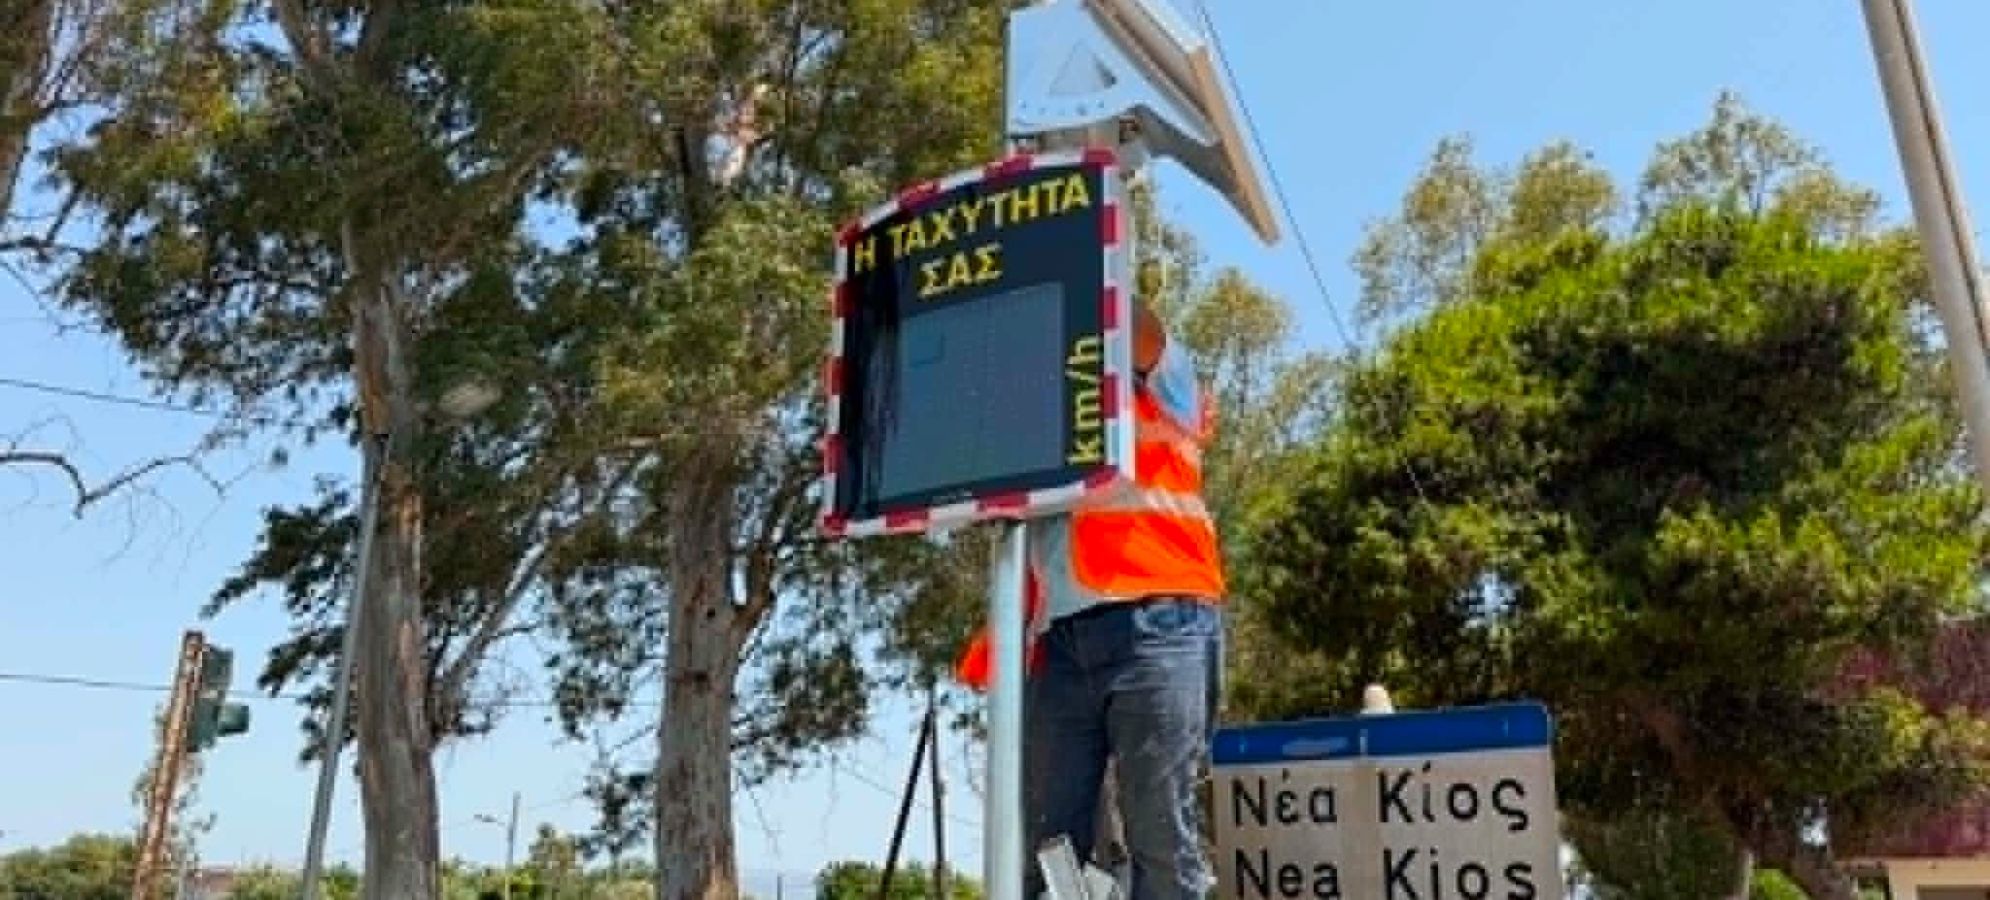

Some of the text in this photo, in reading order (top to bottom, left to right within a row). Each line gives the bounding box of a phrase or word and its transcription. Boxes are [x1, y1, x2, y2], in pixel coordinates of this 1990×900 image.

[854, 173, 1090, 273] Η ΤΑΧΥΤΗΤΑ
[919, 243, 1003, 297] ΣΑΣ
[1067, 335, 1104, 464] km/h
[1231, 760, 1530, 832] Νέα Κίος
[1235, 848, 1537, 900] Nea Kios
